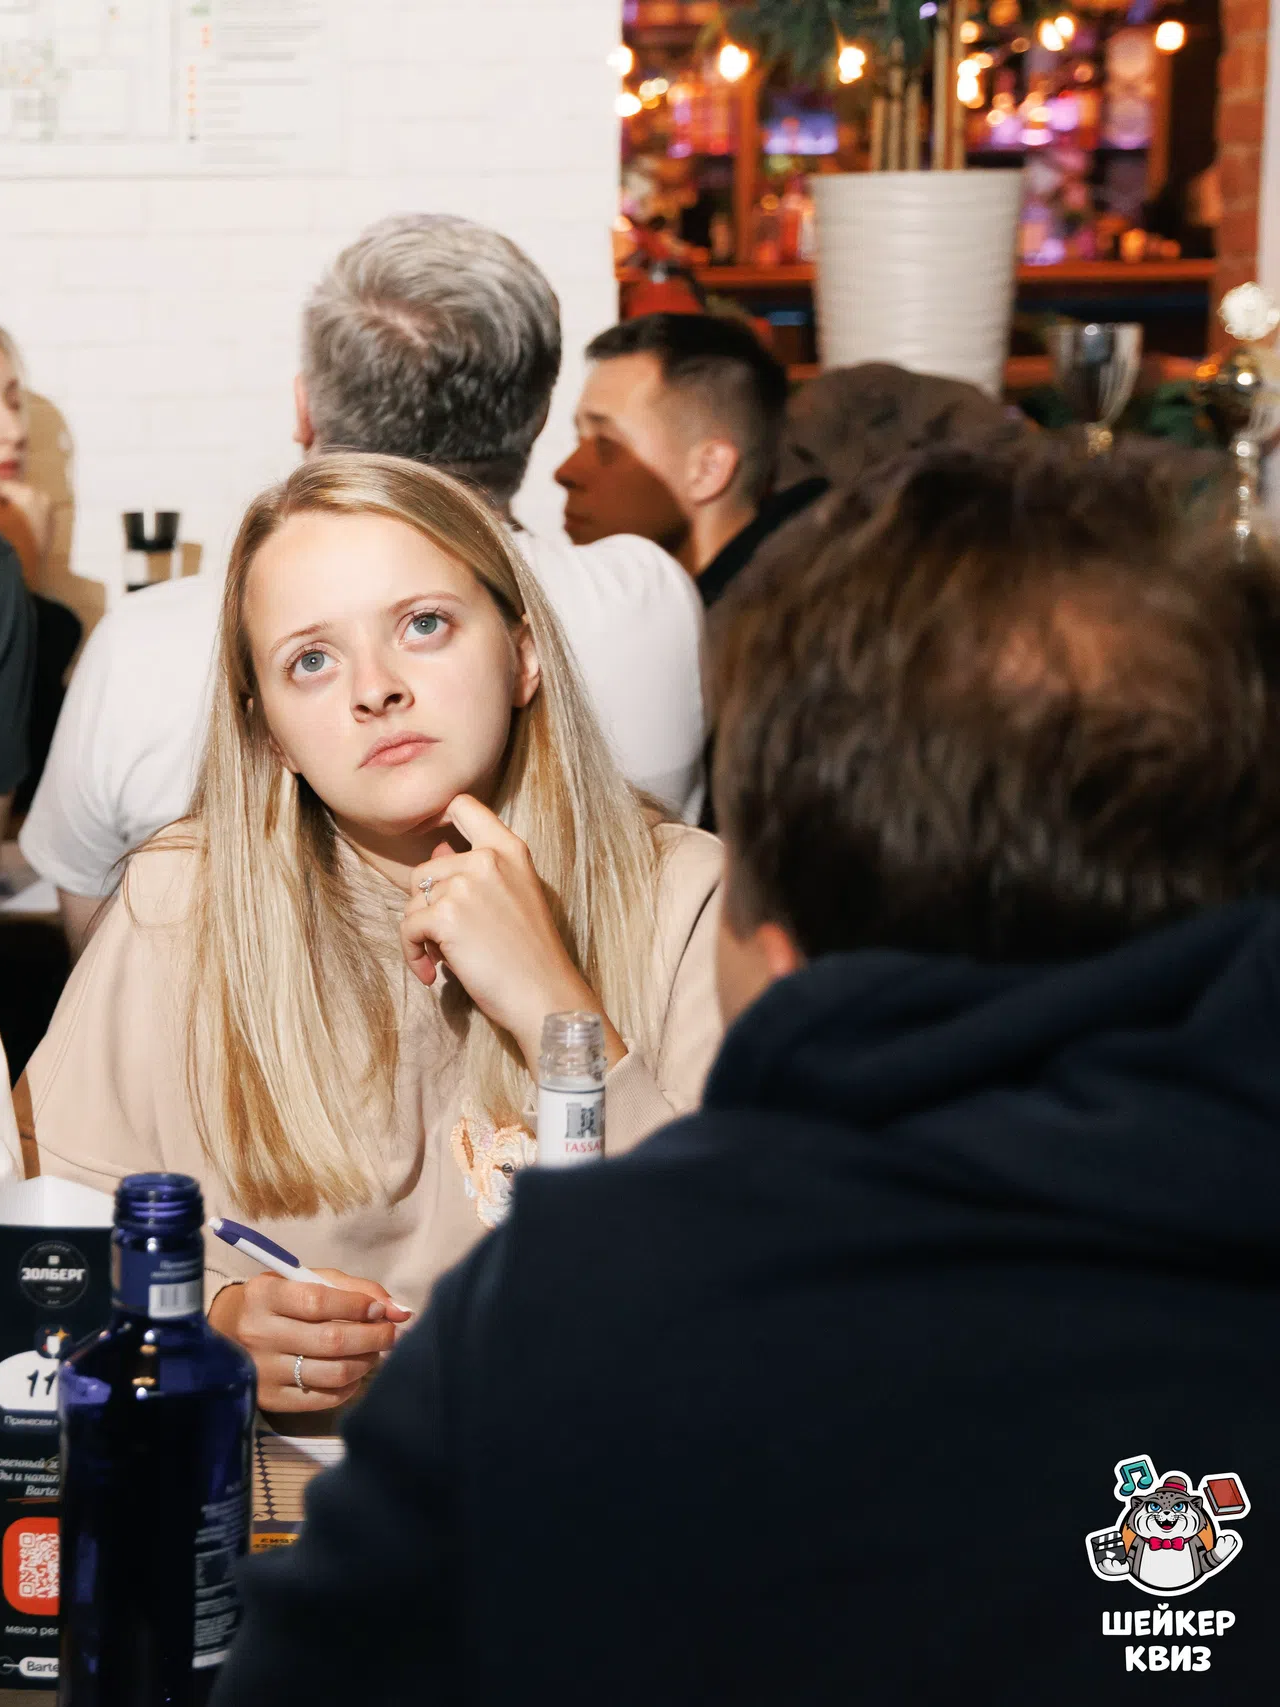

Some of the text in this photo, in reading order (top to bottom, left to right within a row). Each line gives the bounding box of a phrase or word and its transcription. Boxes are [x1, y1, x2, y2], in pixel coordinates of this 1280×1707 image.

[21, 1267, 86, 1281] ЗОЛБЕРГ
[15, 1473, 22, 1481] и
[5, 1625, 38, 1635] меню
